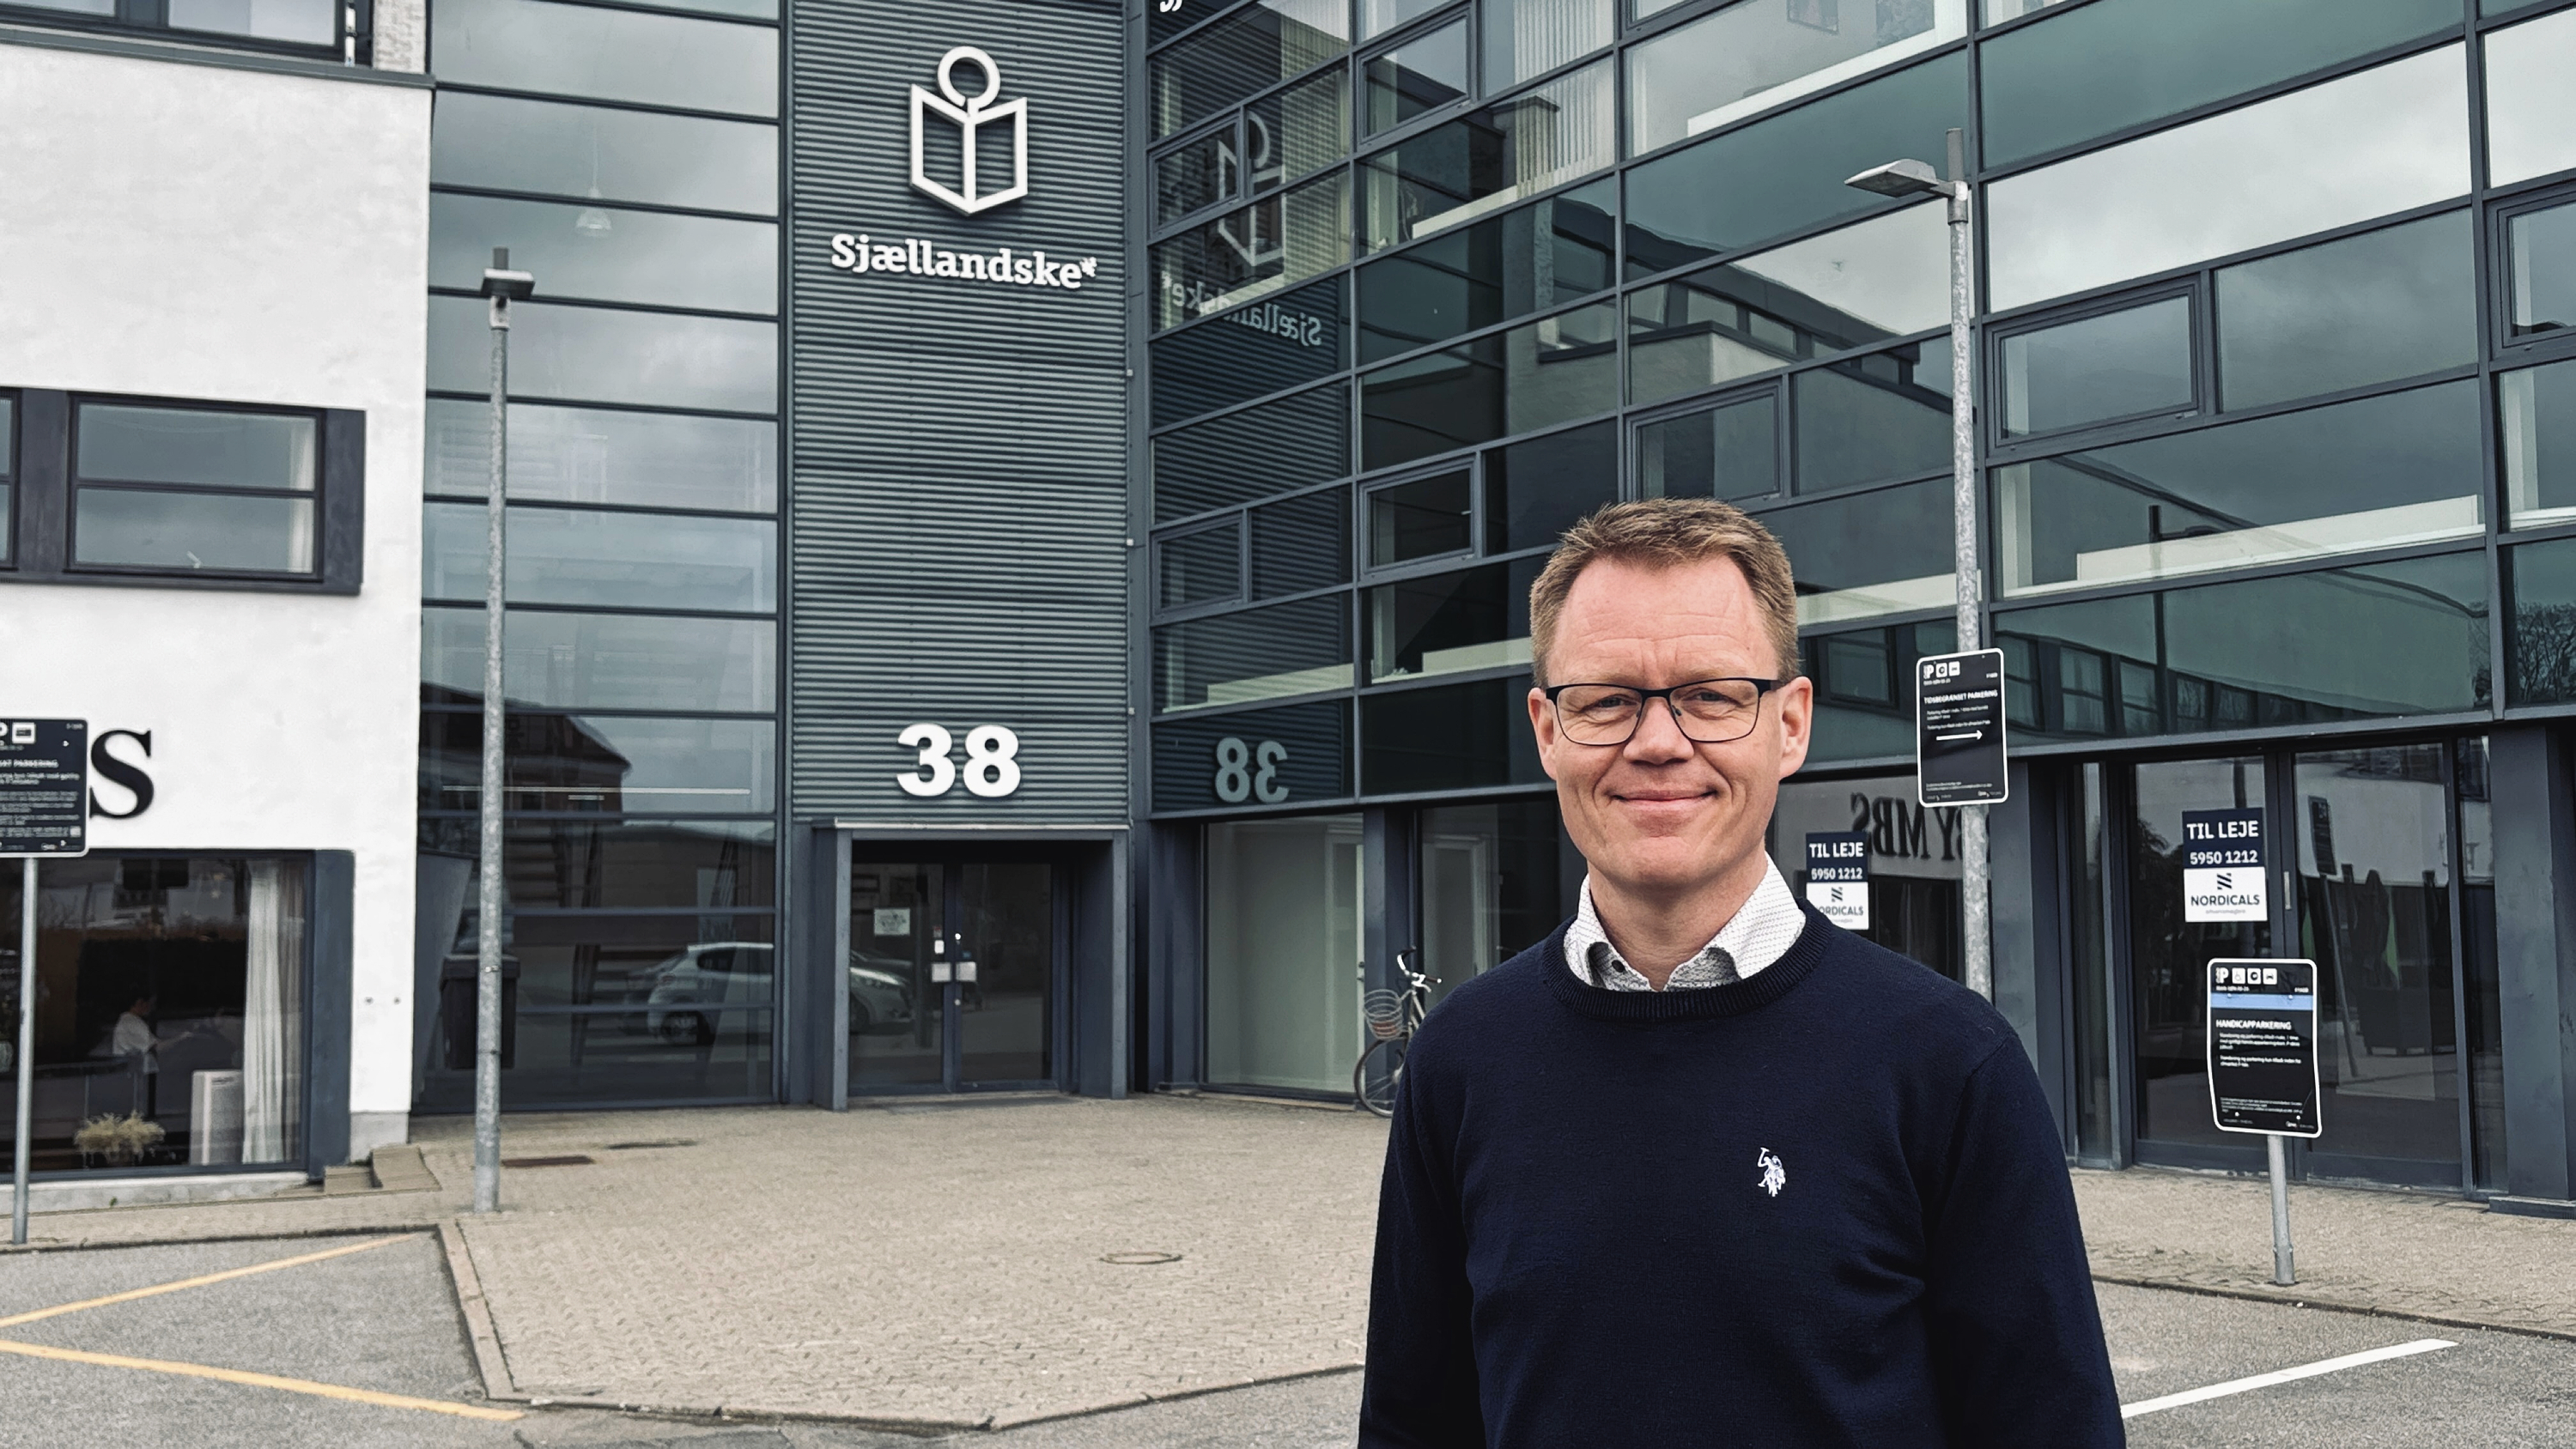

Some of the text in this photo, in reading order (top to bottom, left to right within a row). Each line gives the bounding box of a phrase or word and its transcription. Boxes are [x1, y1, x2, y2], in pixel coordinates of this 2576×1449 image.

[830, 233, 1083, 289] Sjællandske
[896, 724, 1022, 797] 38
[2186, 820, 2259, 840] TIL LEJE
[1809, 842, 1864, 858] TIL LEJE
[2190, 849, 2258, 865] 5950 1212
[1811, 867, 1863, 881] 5950 1212
[2190, 894, 2260, 906] NORDICALS
[1816, 905, 1864, 916] ORDICALS
